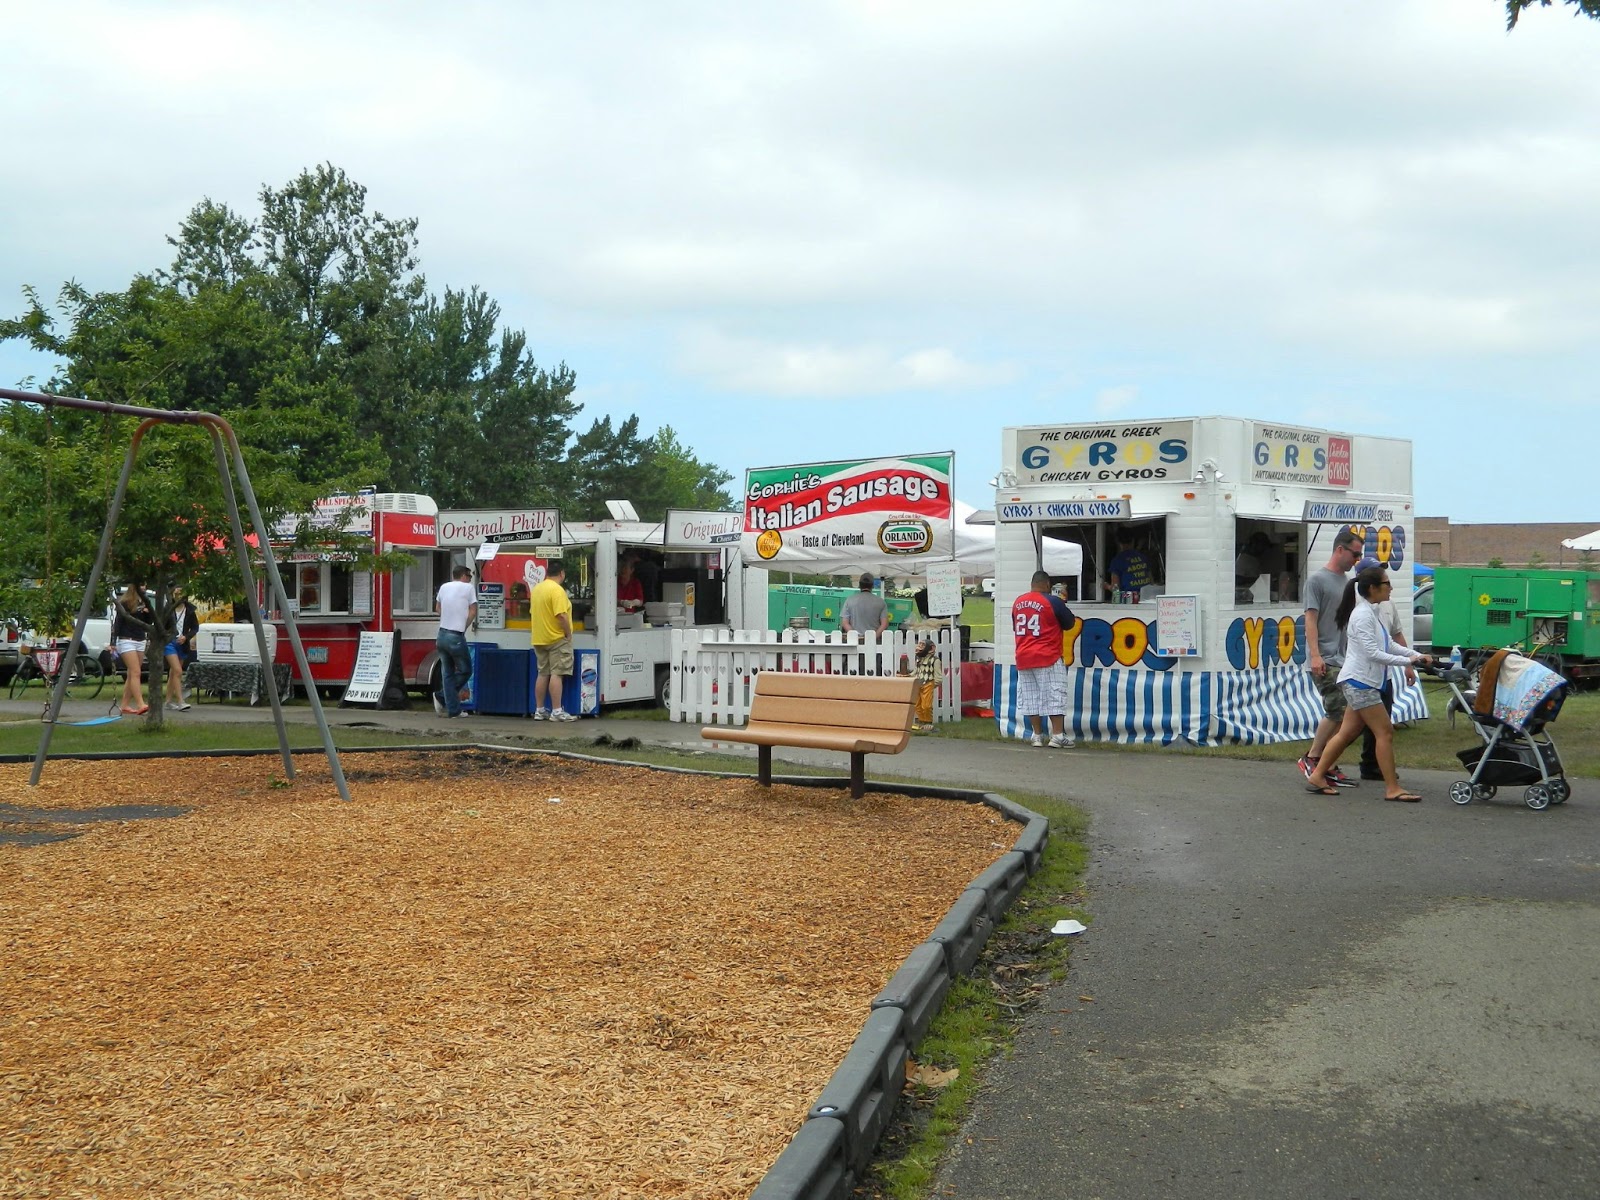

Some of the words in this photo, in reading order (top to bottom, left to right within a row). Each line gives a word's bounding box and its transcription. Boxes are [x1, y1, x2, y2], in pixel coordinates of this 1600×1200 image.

[1040, 432, 1061, 441] THE
[1064, 429, 1116, 440] ORIGINAL
[1122, 427, 1162, 437] GREEK
[1262, 429, 1273, 438] THE
[1274, 431, 1300, 441] ORIGINAL
[1302, 434, 1320, 444] GREEK
[1022, 439, 1188, 469] GYROS
[1254, 441, 1326, 471] GYROS
[1329, 442, 1348, 458] Chicken
[1040, 471, 1091, 482] CHICKEN
[1098, 468, 1167, 480] GYROS
[1329, 463, 1349, 481] GYROS
[750, 499, 822, 530] Italian
[826, 475, 938, 514] Sausage
[1003, 505, 1033, 517] GYROS
[1047, 503, 1084, 516] CHICKEN
[1089, 502, 1121, 516] GYROS
[1309, 504, 1328, 518] GYROS
[1358, 506, 1375, 520] GYROS
[1378, 510, 1393, 521] GREEK
[412, 522, 435, 535] SARG
[443, 517, 504, 543] Original
[511, 511, 555, 531] Philly
[683, 517, 727, 540] Original
[493, 535, 514, 543] Cheese
[802, 535, 818, 547] Taste
[822, 534, 829, 547] of
[832, 532, 864, 546] Cleveland
[885, 532, 925, 541] ORLANDO
[786, 586, 811, 594] WACKER
[1016, 600, 1044, 612] SIZEMORE
[1016, 613, 1040, 636] 24
[347, 690, 359, 698] POP
[361, 691, 381, 699] WATER
